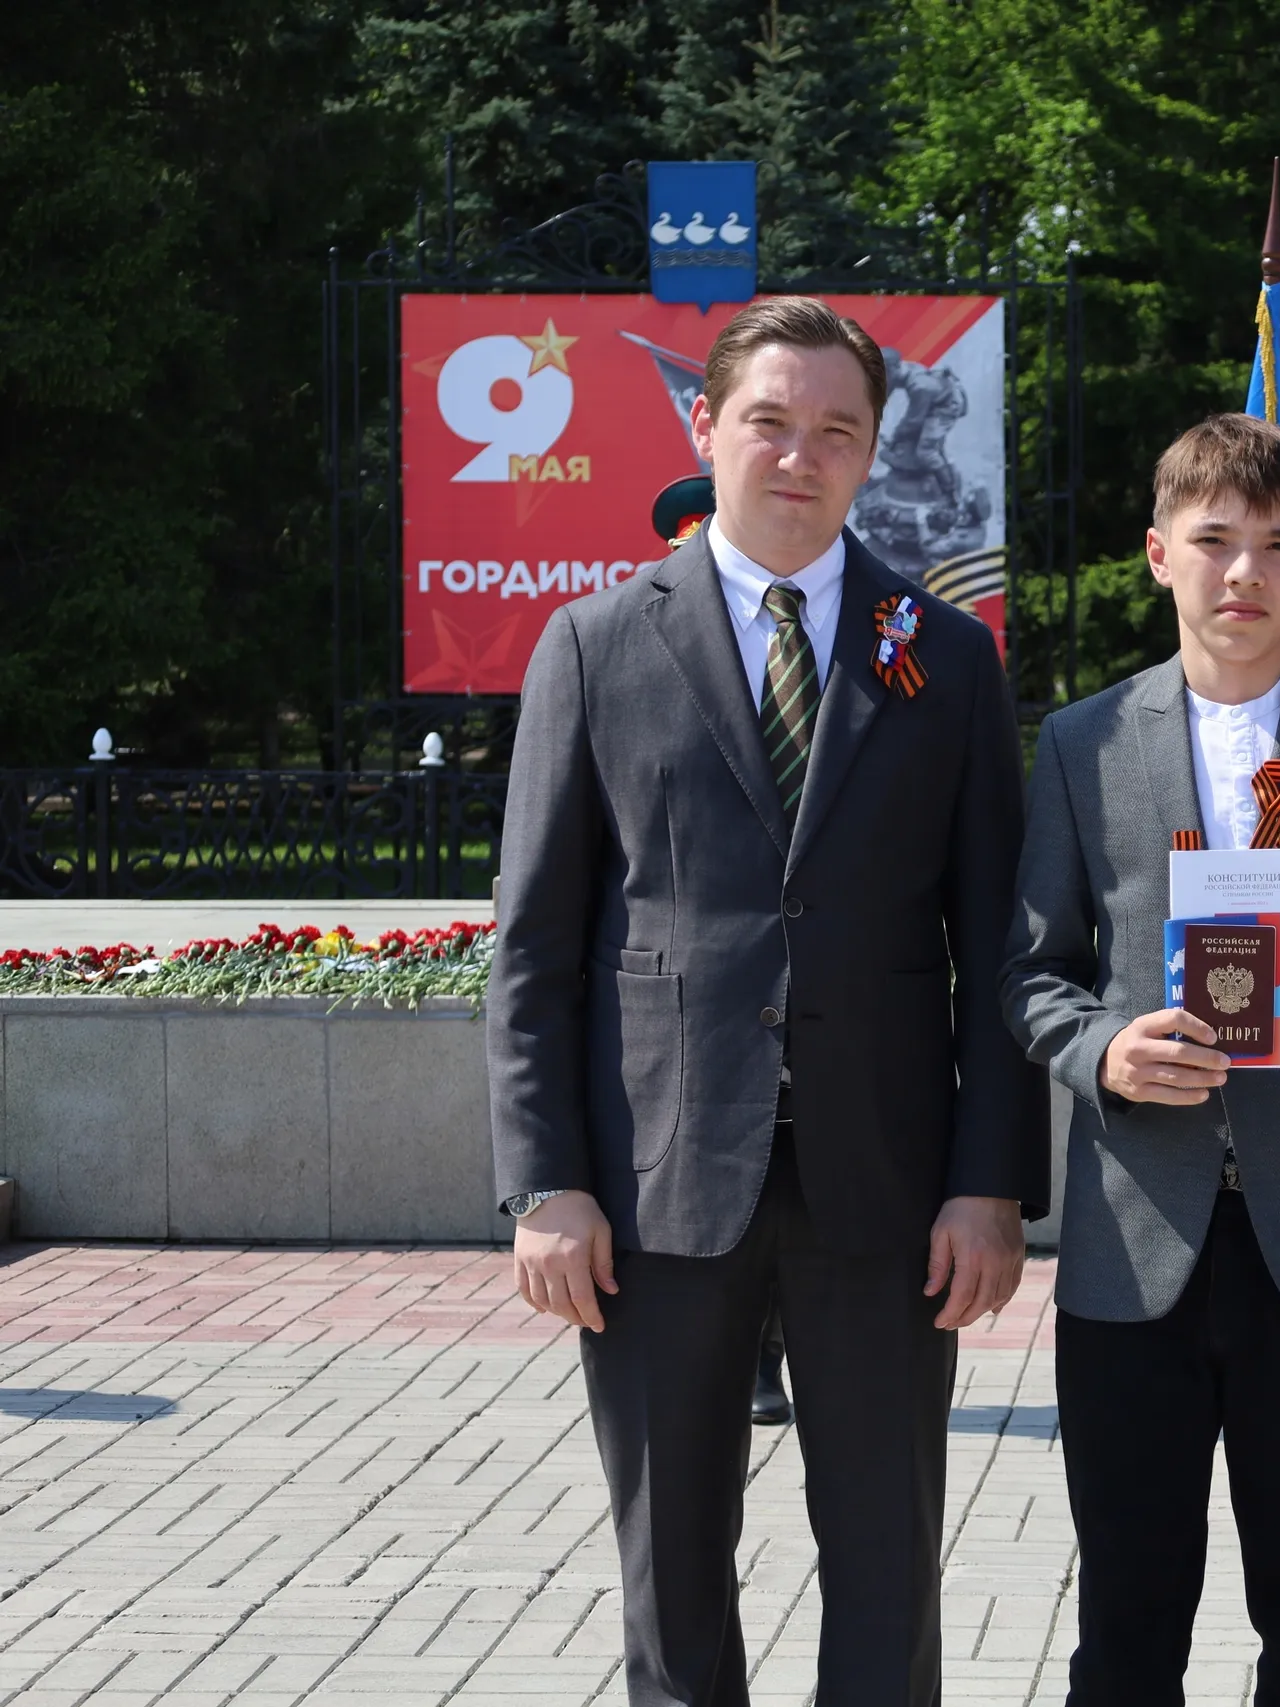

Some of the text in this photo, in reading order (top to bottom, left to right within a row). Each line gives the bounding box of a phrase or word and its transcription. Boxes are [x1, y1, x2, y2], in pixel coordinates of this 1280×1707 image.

[437, 334, 591, 482] 9 МАЯ
[418, 560, 662, 599] ГОРДИМС
[1204, 883, 1251, 891] РОССИЙСКОЙ
[1201, 936, 1261, 946] РОССИЙСКАЯ
[1205, 946, 1257, 955] ФЕДЕРАЦИЯ
[1211, 1026, 1261, 1041] СПОРТ
